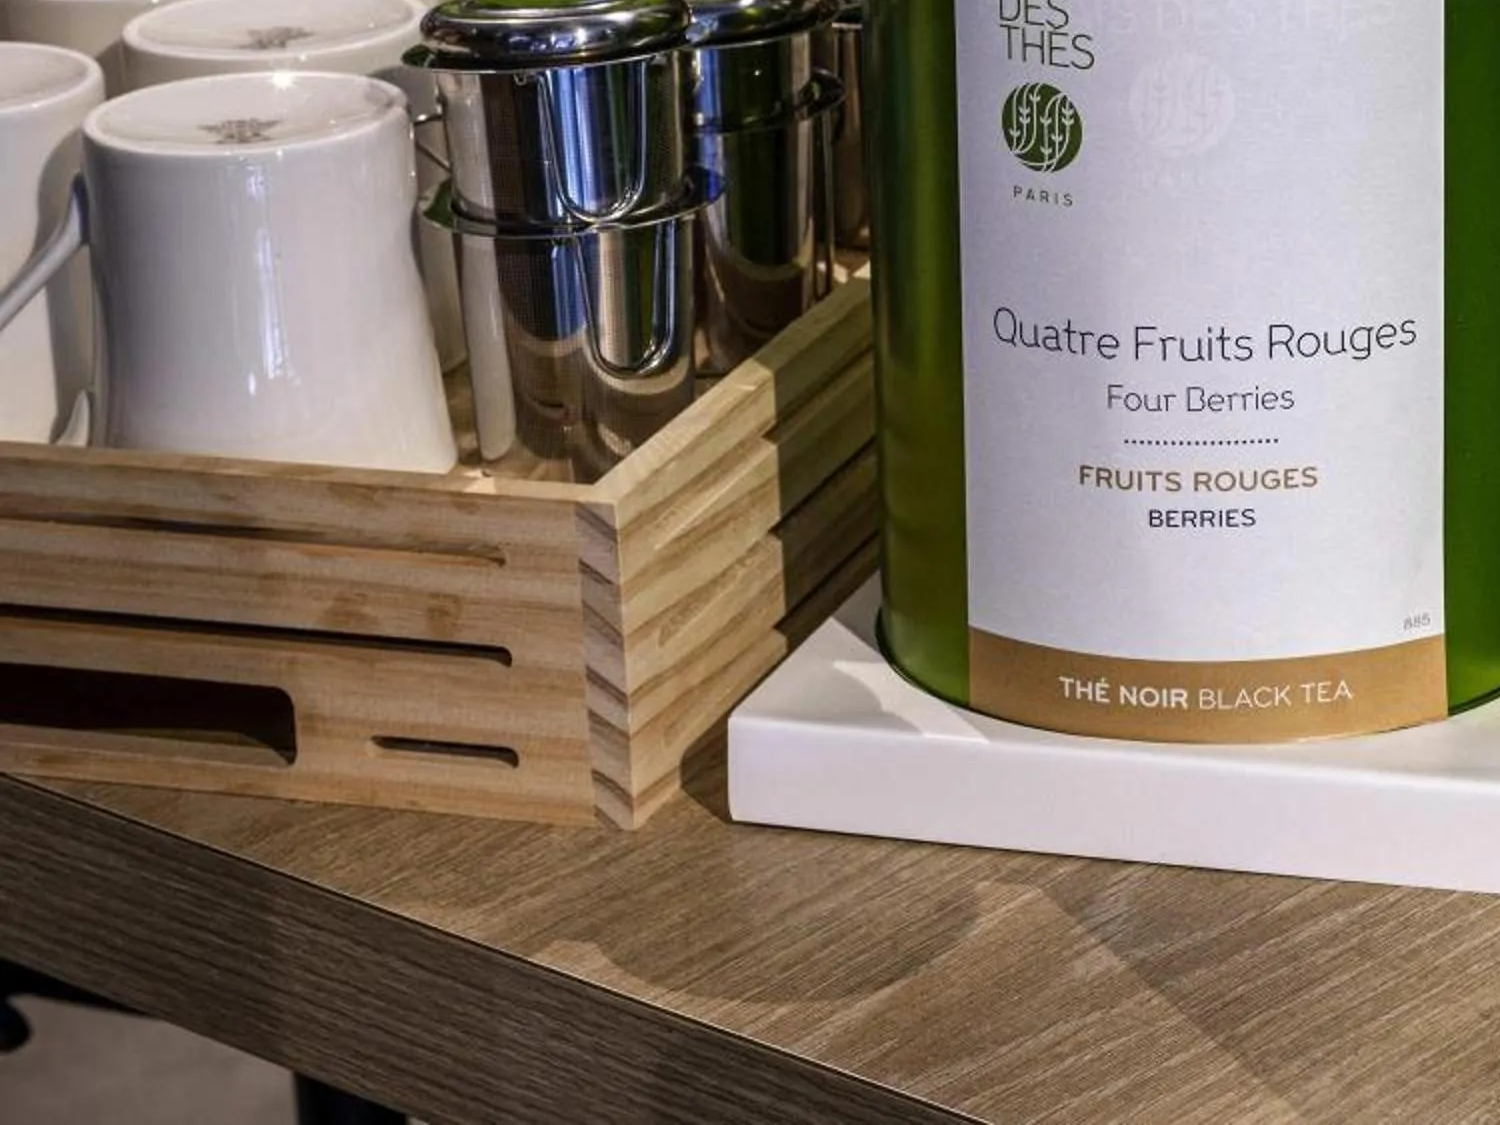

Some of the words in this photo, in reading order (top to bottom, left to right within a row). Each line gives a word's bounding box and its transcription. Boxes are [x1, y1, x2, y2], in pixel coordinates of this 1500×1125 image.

[1013, 185, 1074, 207] PARIS
[993, 307, 1120, 359] Quatre
[1134, 325, 1253, 362] Fruits
[1268, 318, 1417, 361] Rouges
[1107, 384, 1177, 412] Four
[1186, 386, 1295, 413] Berries
[1079, 465, 1182, 493] FRUITS
[1193, 466, 1318, 493] ROUGES
[1148, 509, 1257, 529] BERRIES
[1059, 676, 1110, 703] THÉ
[1119, 686, 1188, 710] NOIR
[1199, 687, 1290, 711] BLACK
[1301, 680, 1353, 707] TEA
